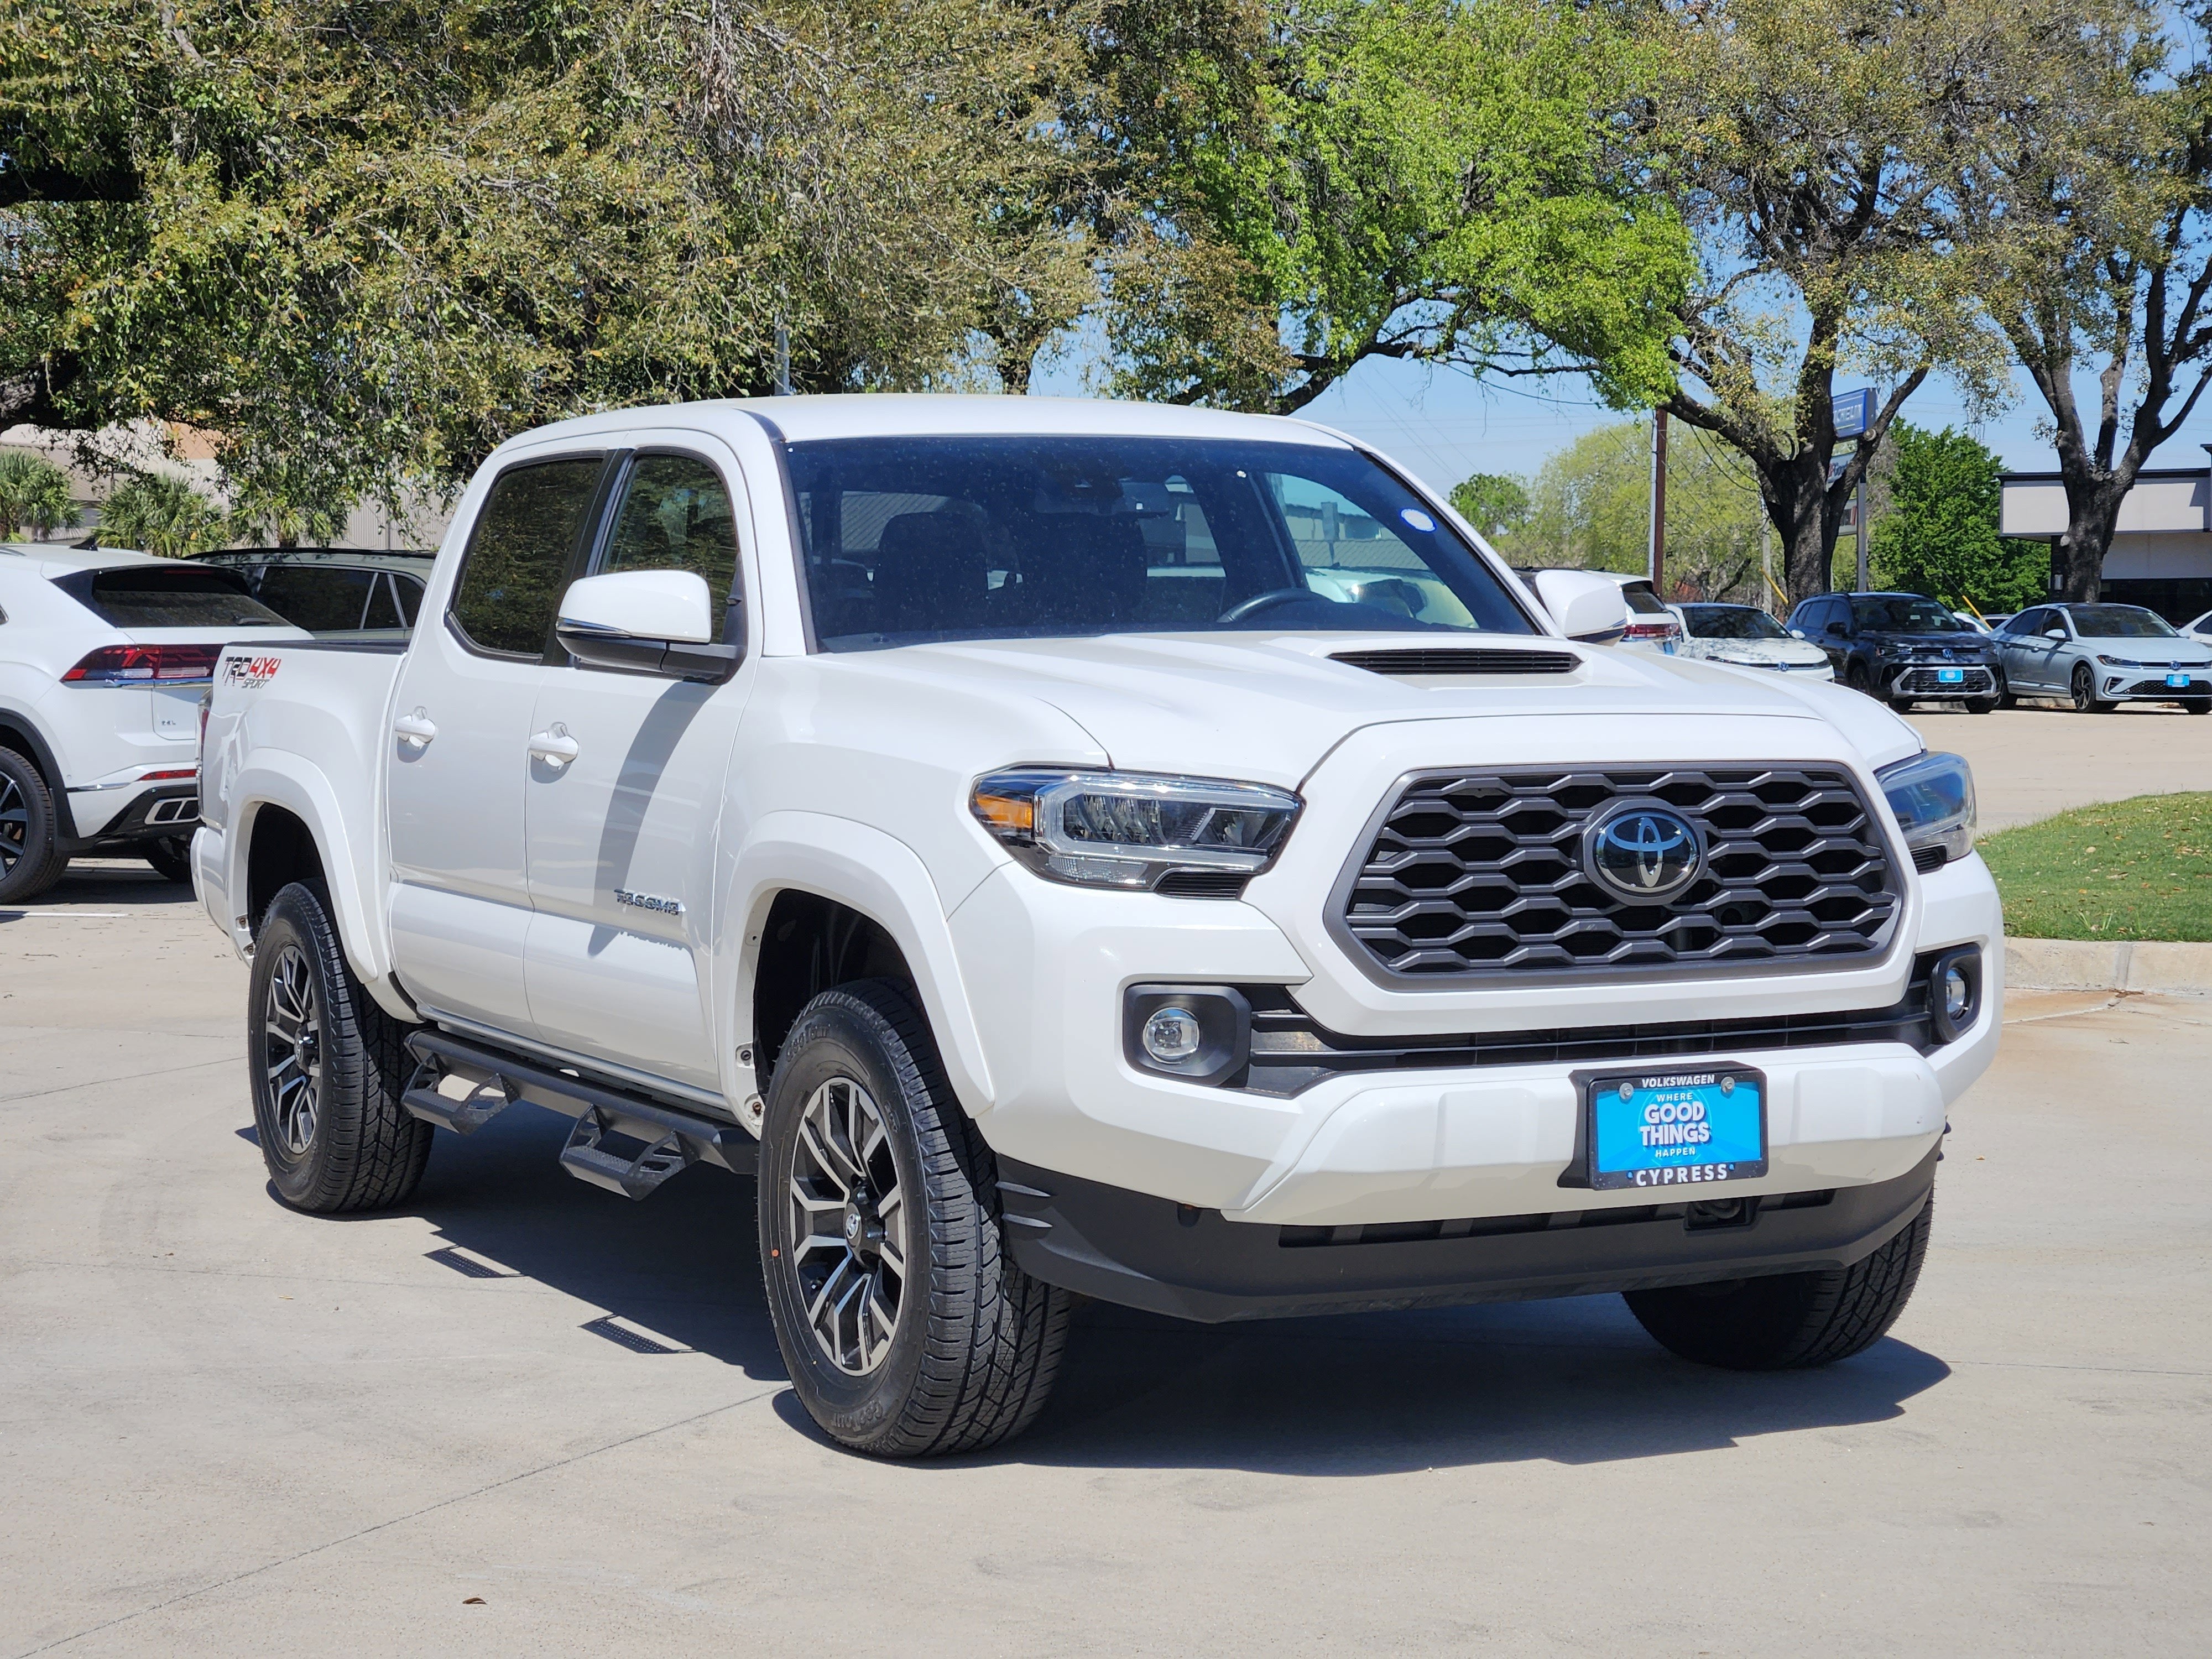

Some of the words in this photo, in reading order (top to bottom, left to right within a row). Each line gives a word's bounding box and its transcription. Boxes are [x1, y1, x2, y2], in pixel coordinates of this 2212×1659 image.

[222, 656, 252, 686] TRD
[241, 678, 270, 689] SPORT
[614, 889, 680, 916] TACOMA
[1641, 1074, 1715, 1089] VOLKSWAGEN
[1656, 1092, 1693, 1102] WHERE
[1644, 1101, 1706, 1124] GOOD
[1640, 1122, 1711, 1146] THINGS
[1655, 1147, 1696, 1158] HAPPEN
[1636, 1164, 1728, 1187] CYPRESS
